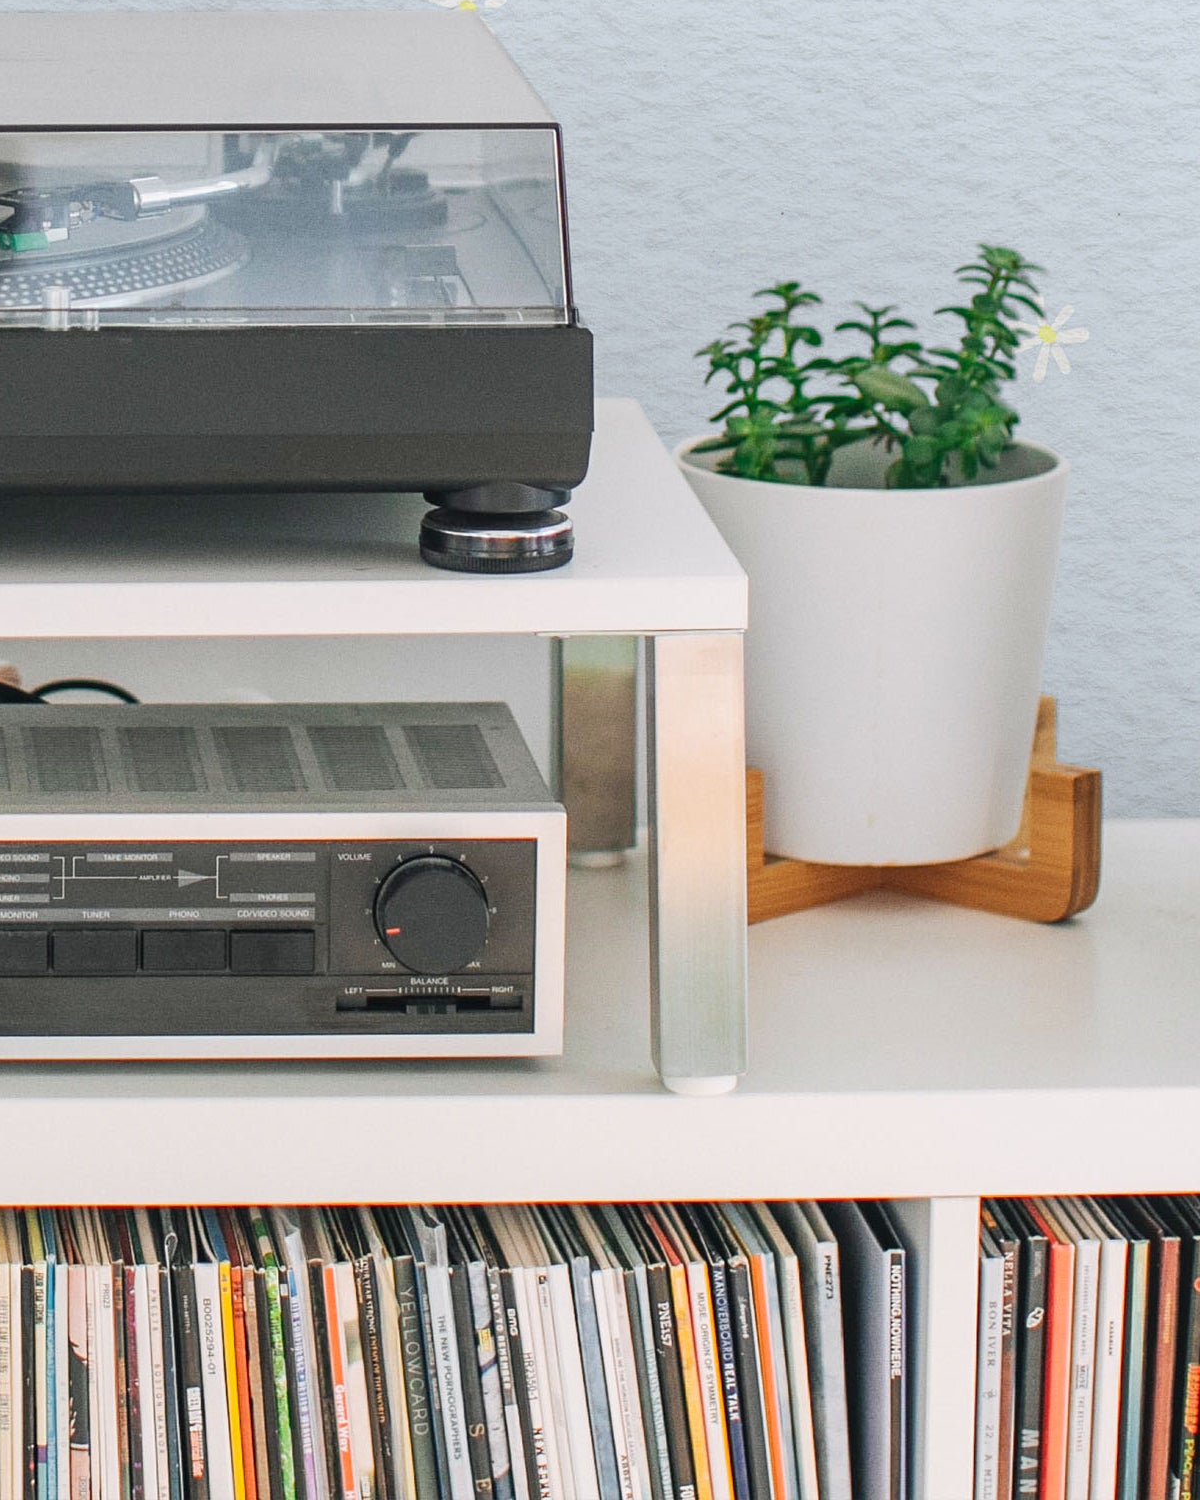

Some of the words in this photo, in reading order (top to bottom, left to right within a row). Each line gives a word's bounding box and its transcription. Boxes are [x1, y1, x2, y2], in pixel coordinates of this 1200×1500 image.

[337, 853, 372, 861] VOLUME
[0, 911, 38, 919] MONITOR
[82, 911, 110, 919] TUNER
[237, 909, 277, 918] CD/VIDEO
[279, 909, 310, 918] SOUND
[410, 977, 449, 986] BALANCE
[823, 1255, 834, 1300] PNE273
[1002, 1251, 1014, 1297] NELLA
[34, 1289, 44, 1302] YEAR
[492, 1293, 502, 1315] DAY
[366, 1300, 376, 1334] STRONG
[436, 1315, 448, 1334] THE
[496, 1318, 504, 1332] TO
[507, 1308, 519, 1337] BMG
[657, 1302, 673, 1347] PNE157
[987, 1301, 998, 1331] BON
[1002, 1304, 1012, 1337] VITA
[203, 1298, 217, 1375] B0025294-01
[439, 1337, 451, 1362] NEW
[701, 1323, 711, 1356] ORIGIN
[986, 1336, 996, 1367] IVER
[400, 1285, 429, 1436] YELLOWCARD
[498, 1336, 511, 1390] REMEMBER
[704, 1357, 713, 1371] OF
[153, 1363, 163, 1408] BOSTON
[724, 1363, 736, 1390] REAL
[334, 1384, 347, 1424] Gerard
[443, 1365, 463, 1460] PORNOGRAPHERS
[707, 1373, 719, 1424] SYMMETRY
[728, 1392, 740, 1423] TALK
[157, 1415, 166, 1455] MANOR
[339, 1426, 350, 1453] Way
